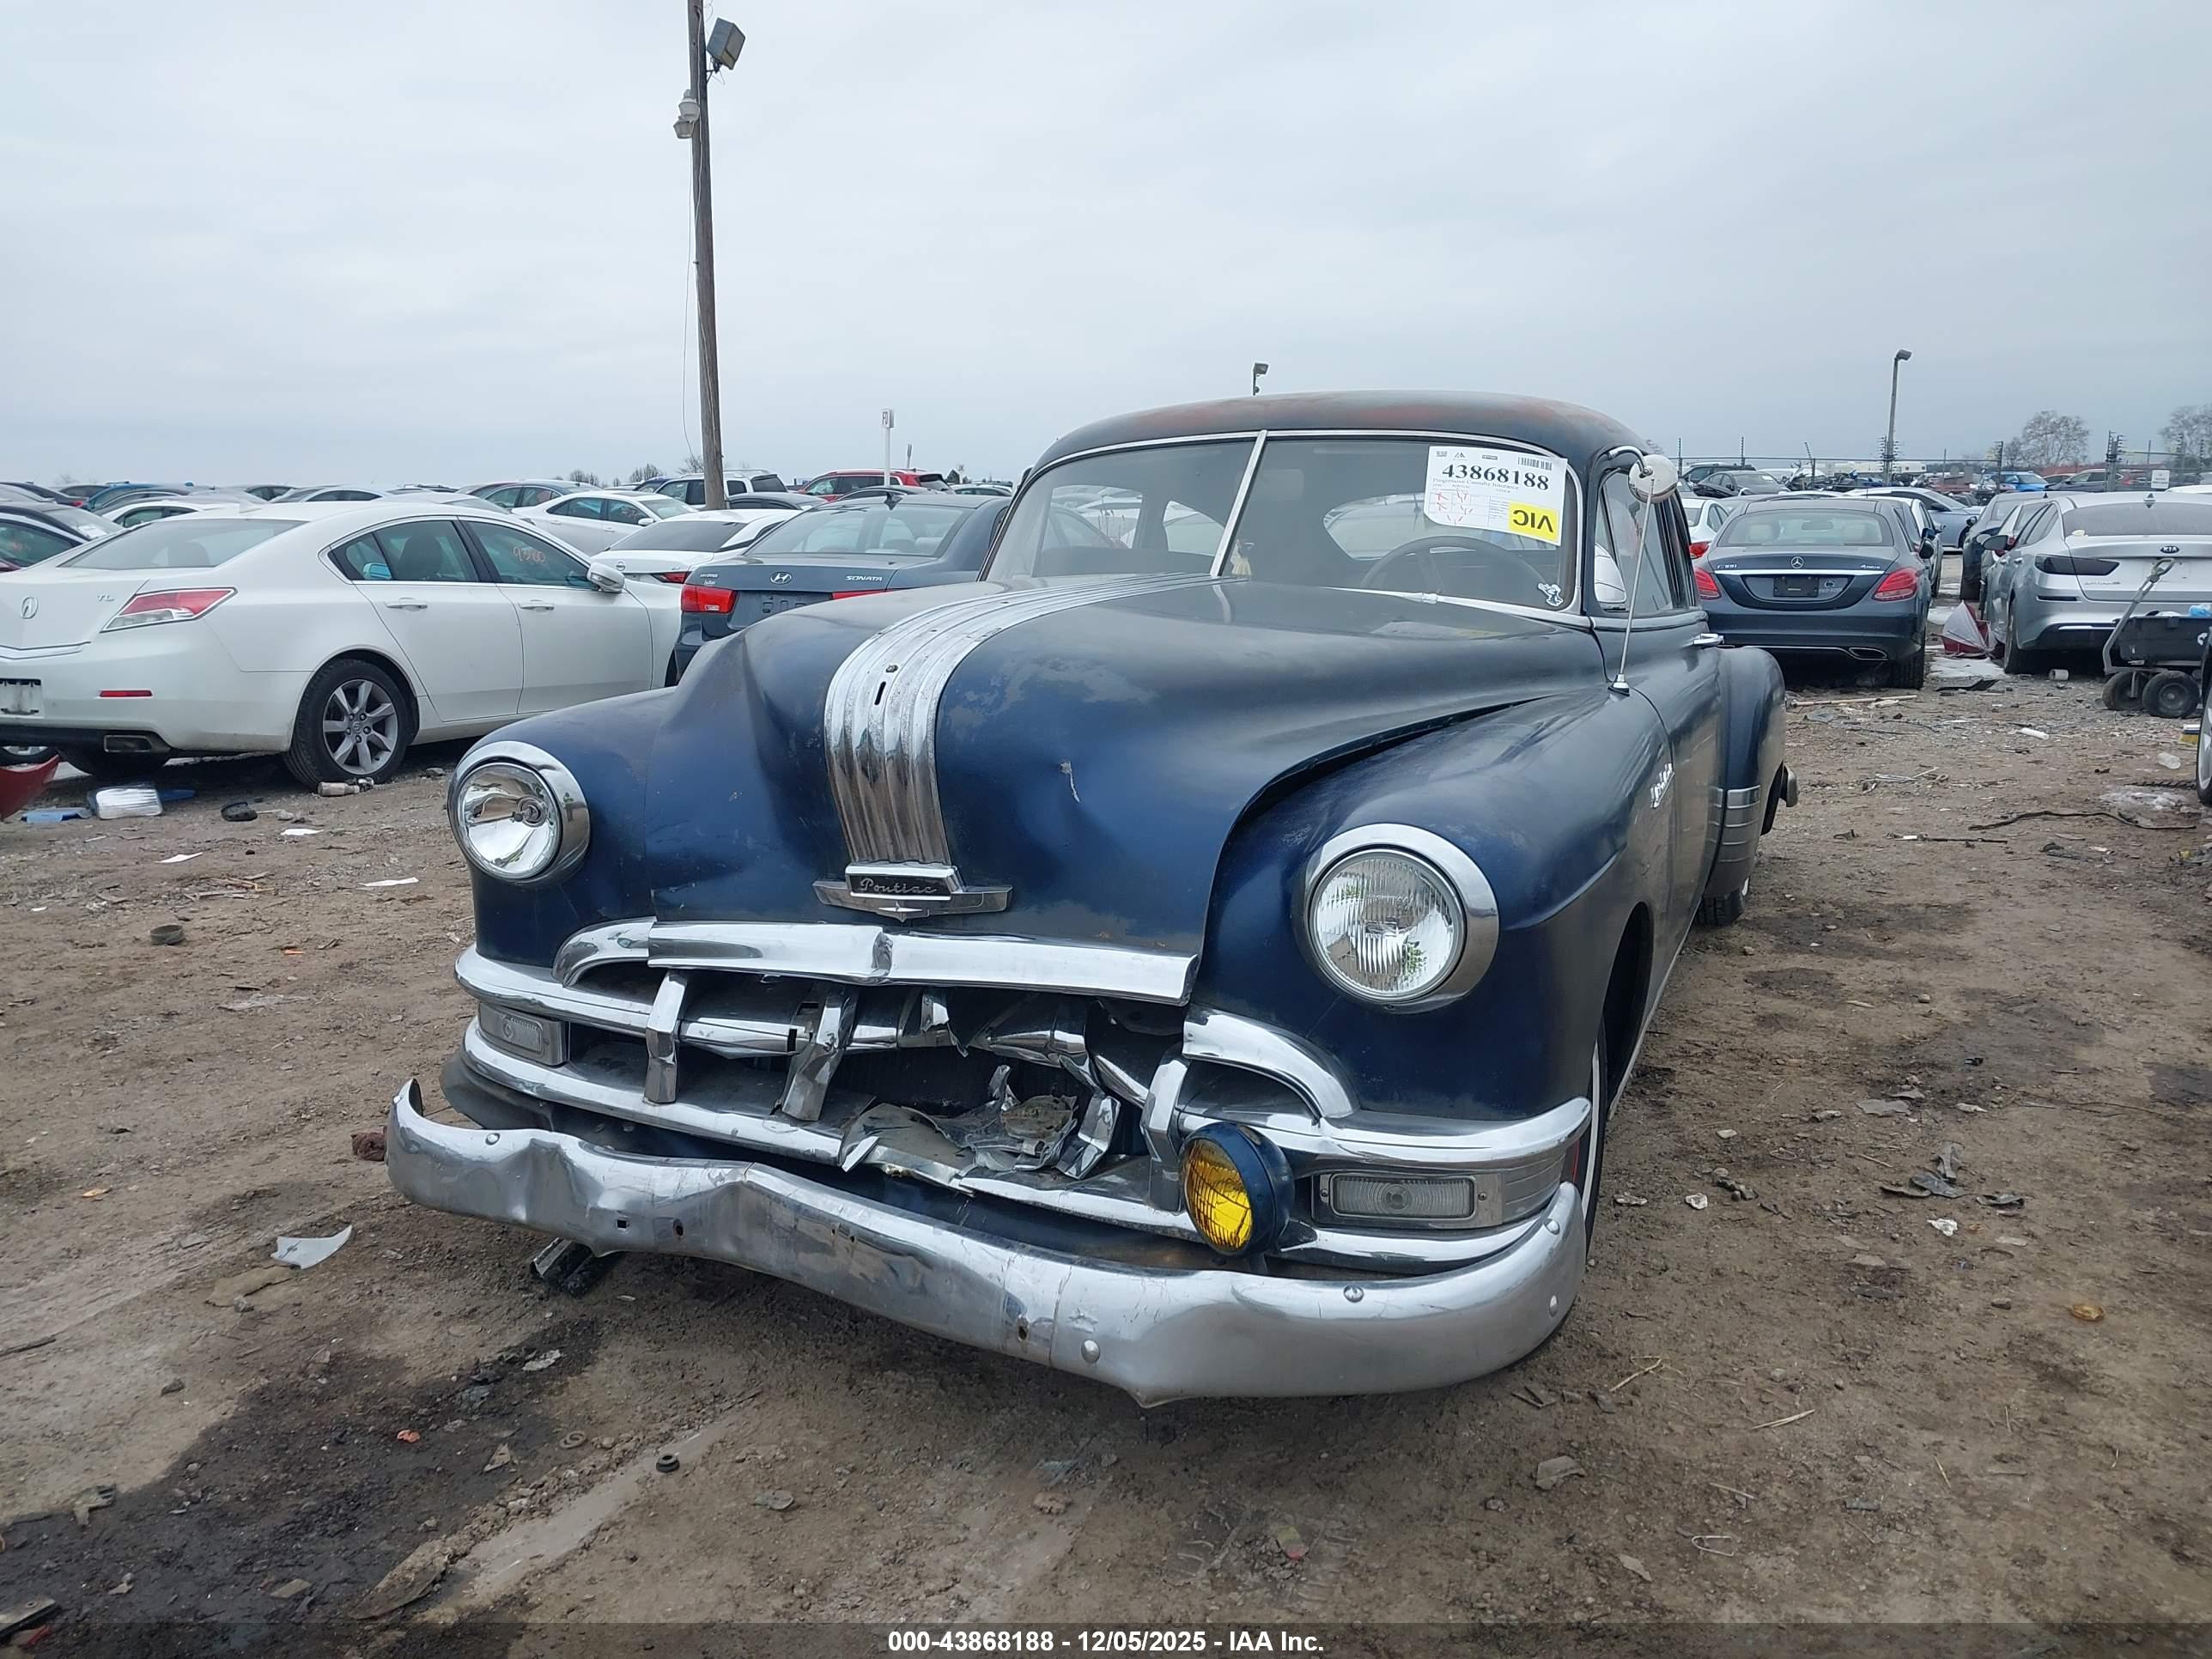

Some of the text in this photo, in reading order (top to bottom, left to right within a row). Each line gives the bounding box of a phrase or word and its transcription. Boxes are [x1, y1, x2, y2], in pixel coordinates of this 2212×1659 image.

[1442, 464, 1549, 490] 43868188
[1512, 509, 1554, 533] VIC
[860, 878, 937, 894] Pontiac
